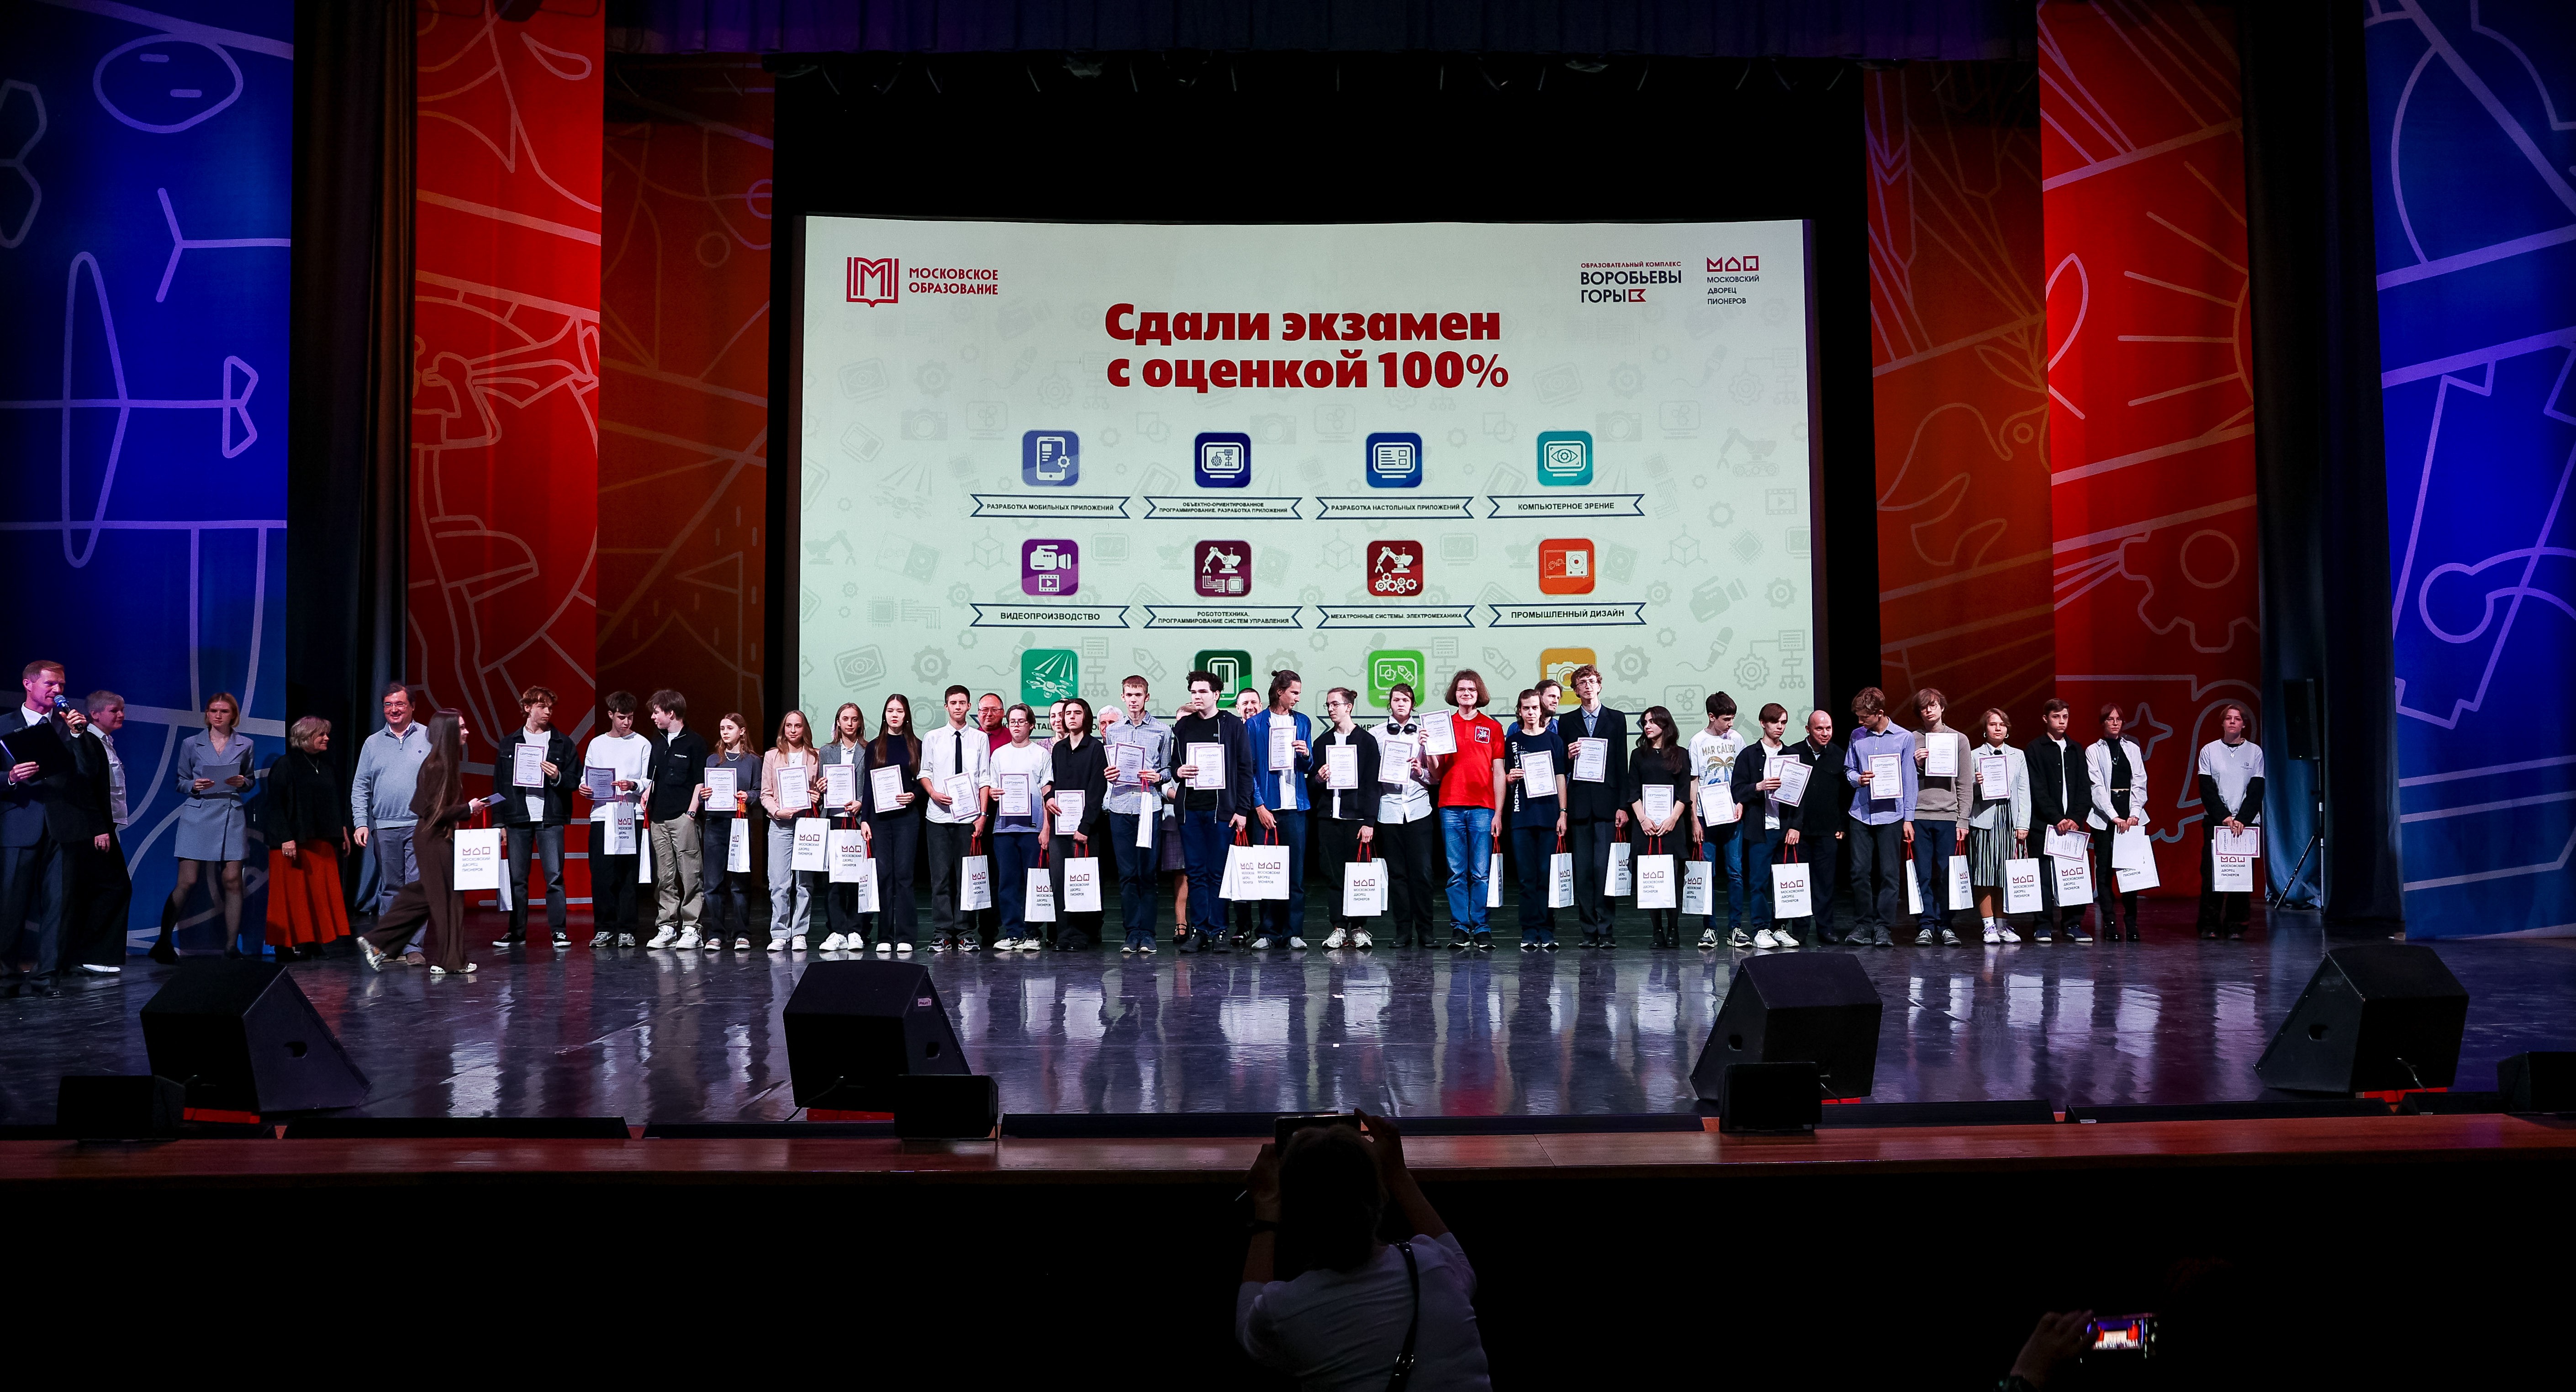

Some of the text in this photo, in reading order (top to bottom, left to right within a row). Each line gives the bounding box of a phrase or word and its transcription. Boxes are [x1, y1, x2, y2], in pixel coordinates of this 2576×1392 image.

[909, 268, 998, 280] МОСКОВСКОЕ
[1581, 270, 1682, 285] ВОРОБЬЕВЫ
[1707, 275, 1759, 283] МОСКОВСКИЙ
[909, 282, 998, 295] ОБРАЗОВАНИЕ
[1581, 289, 1626, 303] ГОРЫ
[1105, 303, 1500, 346] Сдали экзамен
[1107, 349, 1509, 393] с оценкой 100%
[1000, 612, 1100, 621] ВИДЕОПРОИЗВОДСТВО
[1511, 608, 1625, 618] ПРОМЫШЛЕННЫЙ ДИЗАЙН
[1702, 745, 1715, 756] MAR
[1512, 742, 1520, 812] MOSRICS.RU
